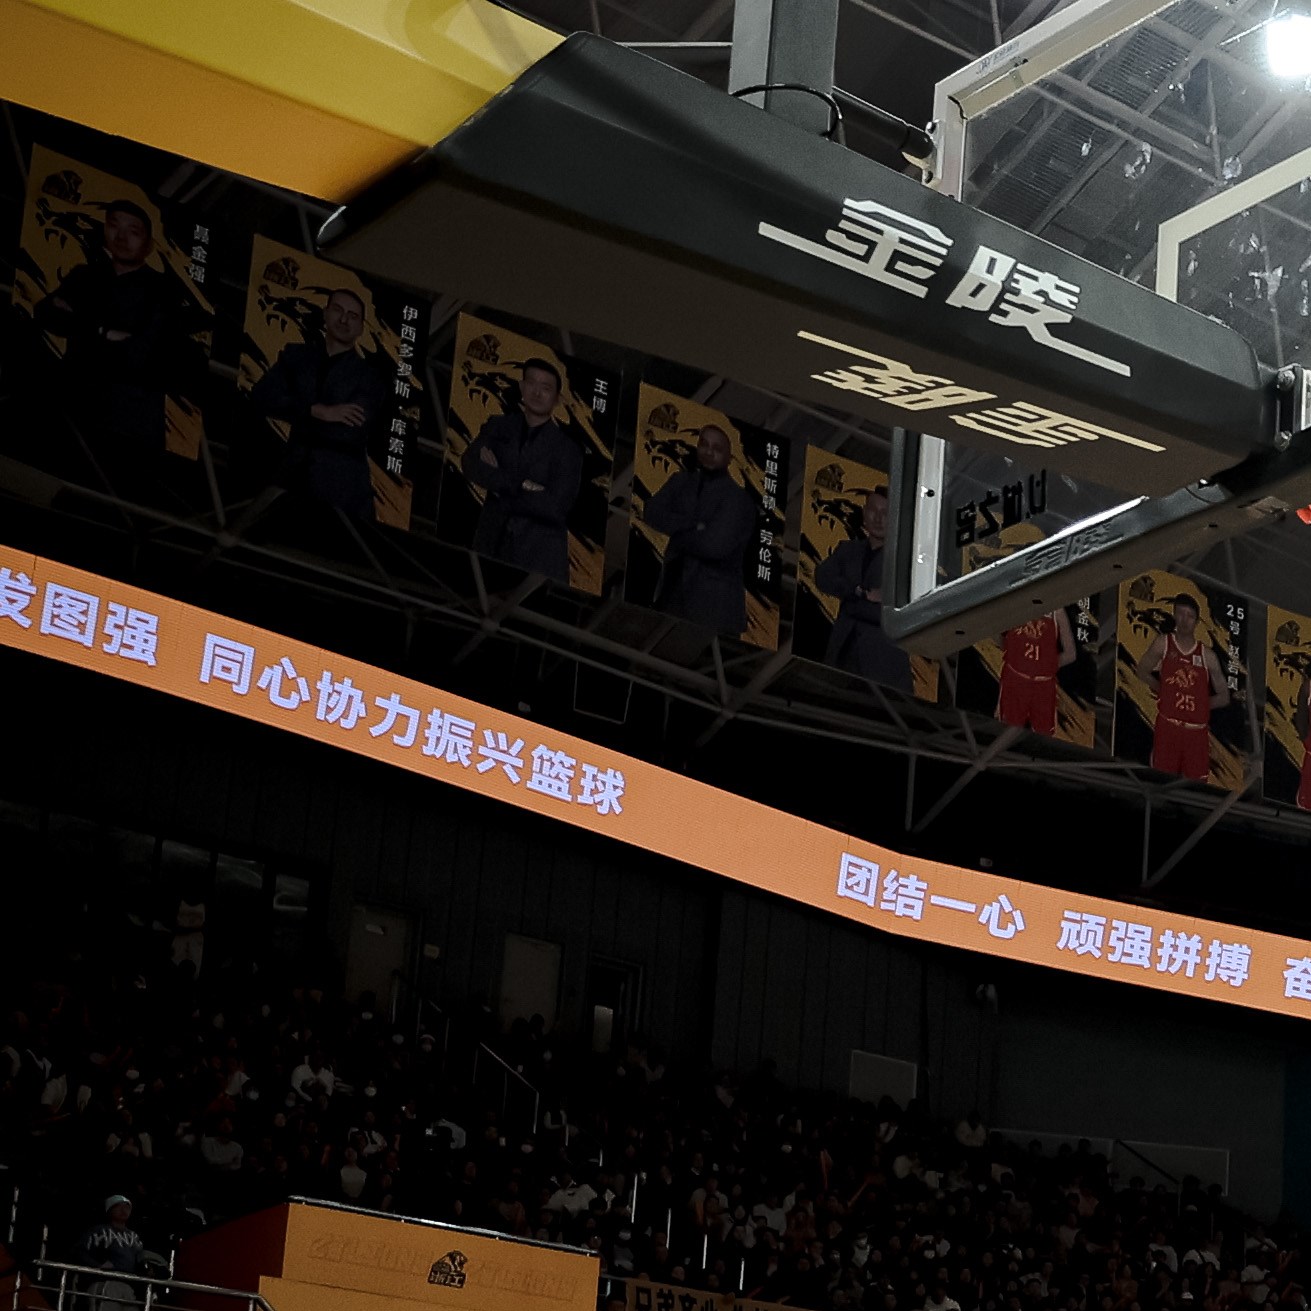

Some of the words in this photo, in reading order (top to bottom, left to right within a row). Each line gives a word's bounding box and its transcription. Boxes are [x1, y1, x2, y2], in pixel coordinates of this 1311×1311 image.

[758, 197, 1132, 378] 金陵
[199, 631, 626, 816] 同心协力振兴篮球
[836, 851, 1026, 940] 团结一心
[1055, 909, 1252, 988] 顽强拼搏
